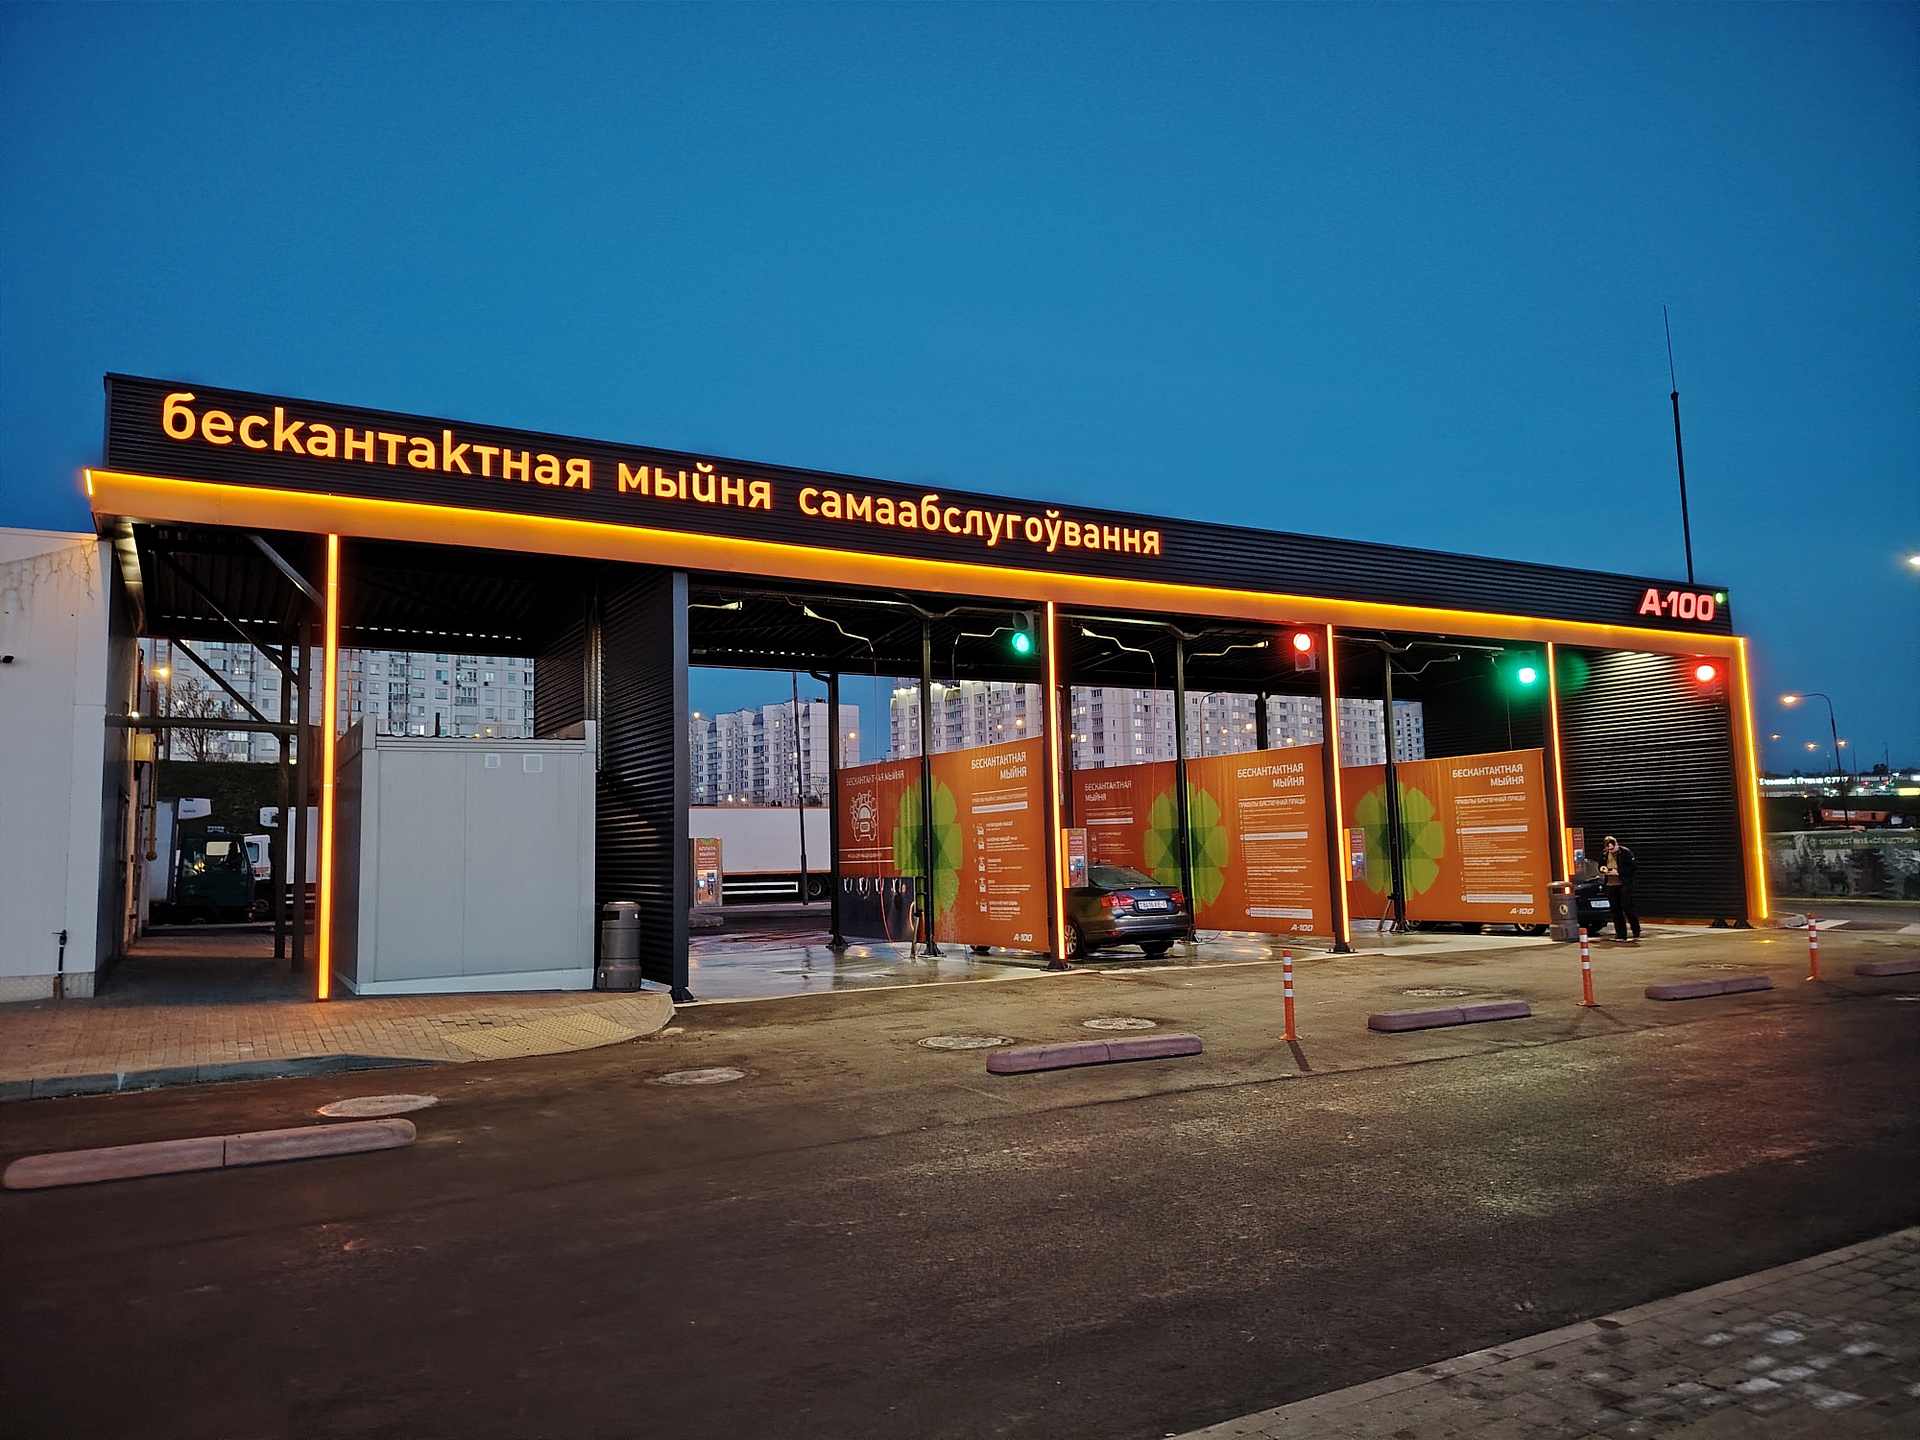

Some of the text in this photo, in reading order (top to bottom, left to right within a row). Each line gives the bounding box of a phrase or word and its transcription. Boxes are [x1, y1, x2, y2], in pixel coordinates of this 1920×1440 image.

[162, 392, 1161, 555] бескантактная мыйня самаабслугоўвання
[971, 751, 1027, 770] БЕСКАНТАКТНАЯ
[1000, 765, 1027, 780] МЫЙНЯ
[1237, 763, 1304, 779] БЕСКАНТАКТНАЯ
[1452, 763, 1523, 778] БЕСКАНТАКТНАЯ
[1084, 779, 1132, 791] БЕСКАНТАКТНАЯ
[1272, 775, 1305, 788] МЫЙНЯ
[1490, 775, 1524, 787] МЫЙНЯ
[1085, 792, 1107, 802] МЫЙНЯ
